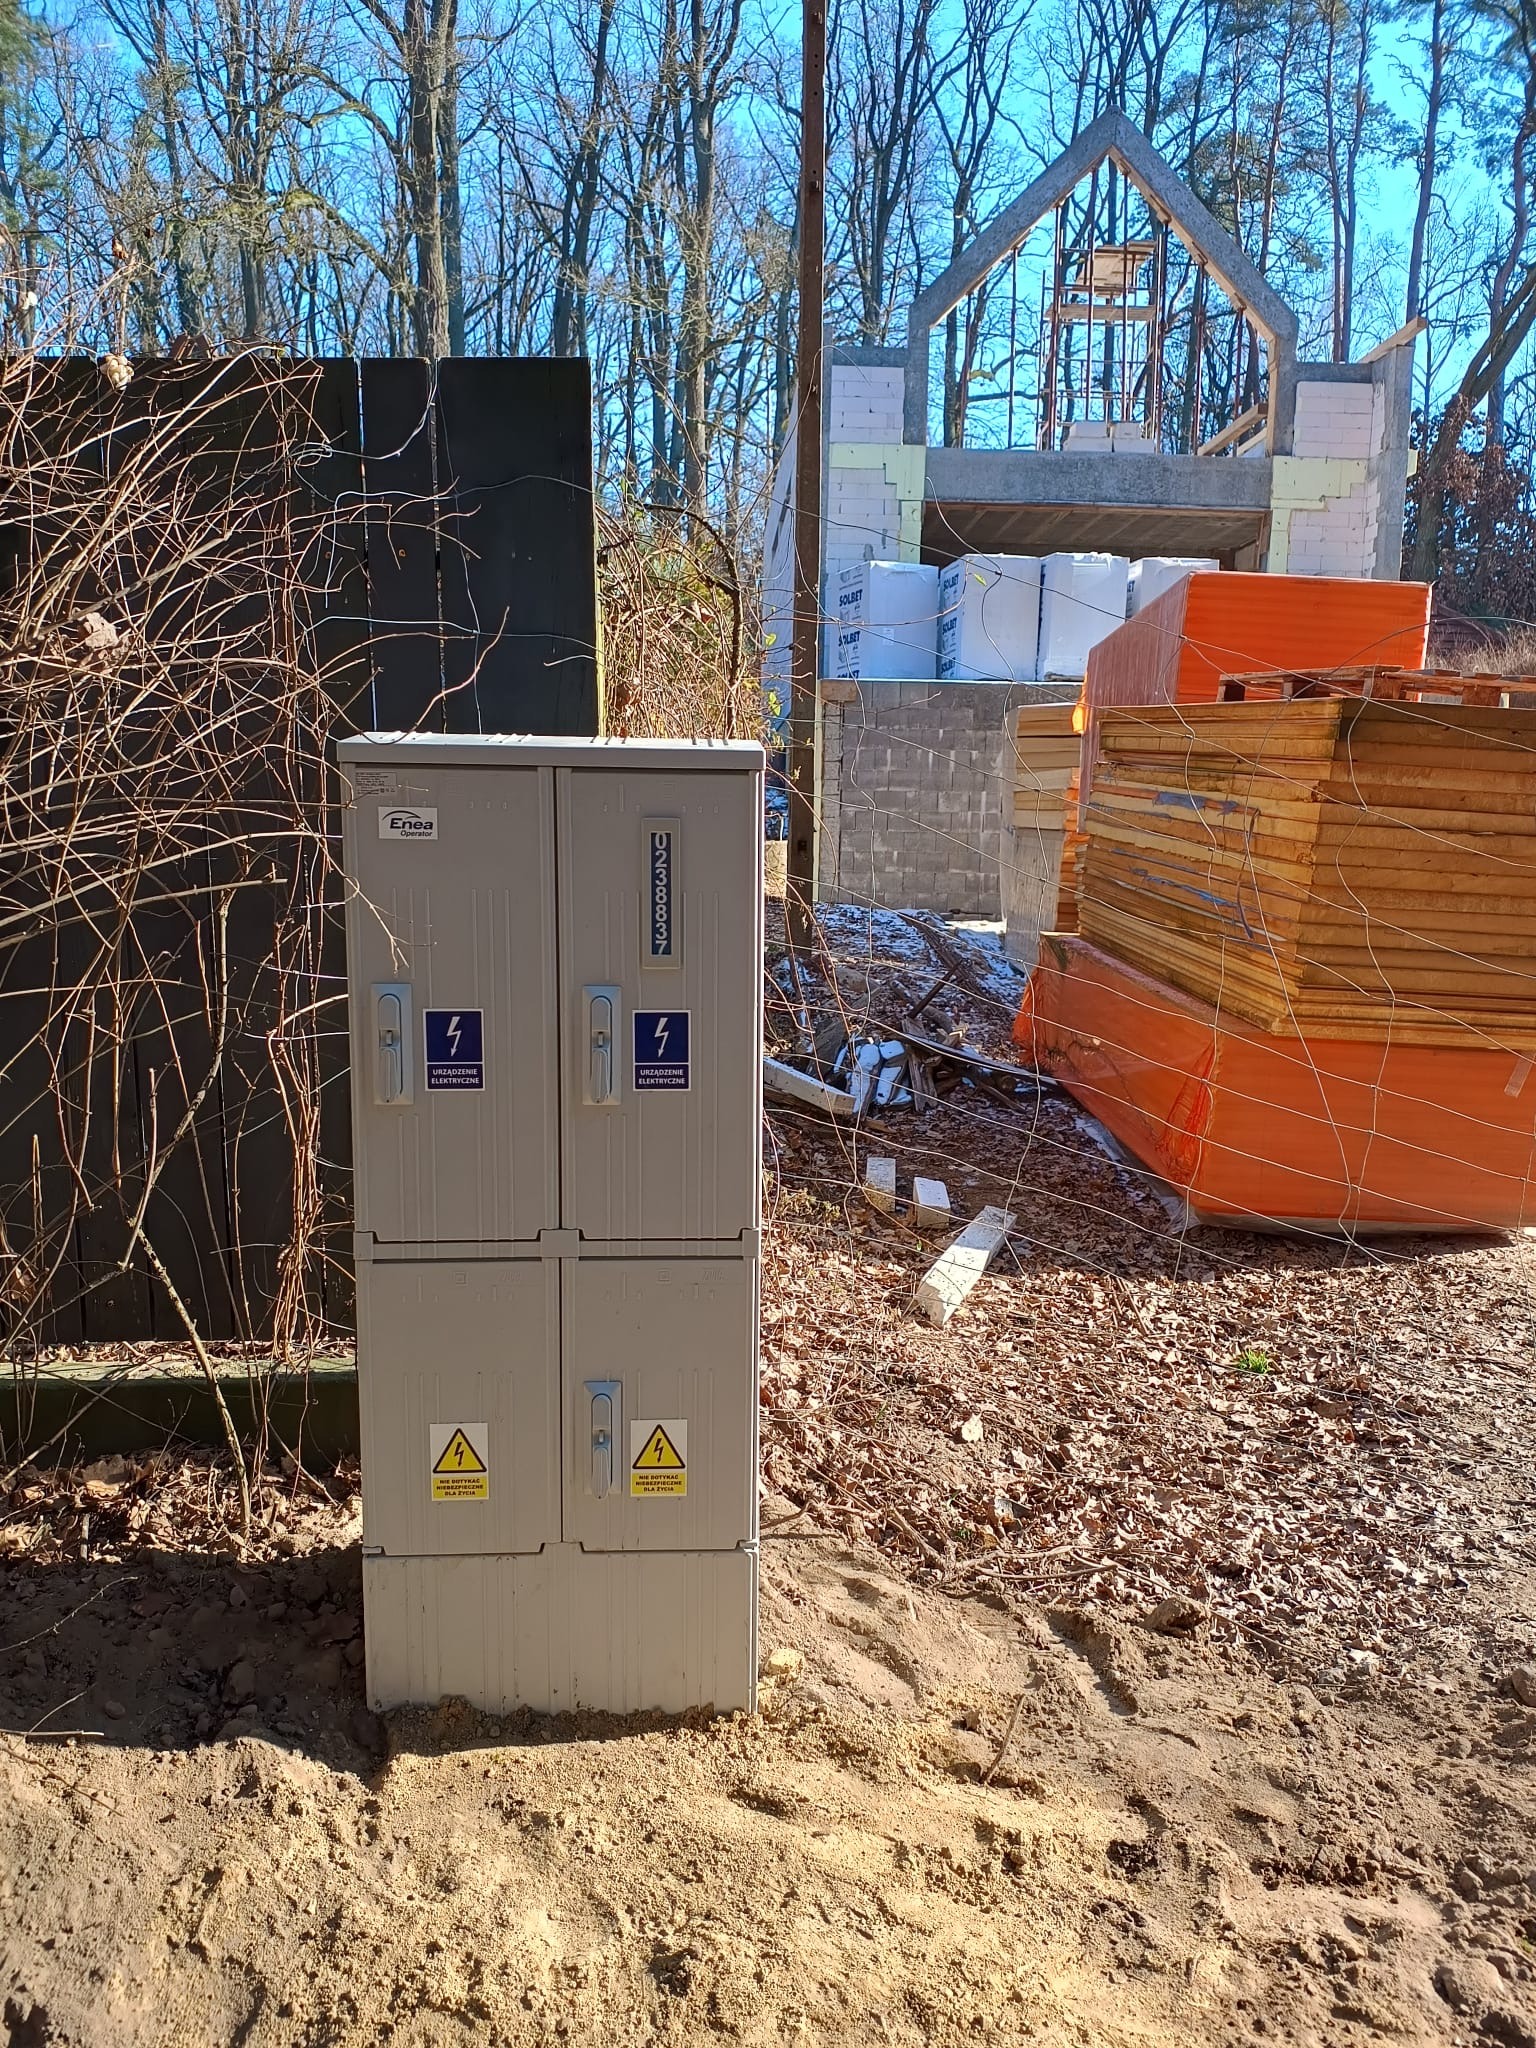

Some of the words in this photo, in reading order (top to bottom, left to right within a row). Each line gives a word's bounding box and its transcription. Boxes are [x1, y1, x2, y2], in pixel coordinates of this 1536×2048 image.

[943, 574, 959, 591] SOLBET
[839, 589, 863, 607] SOLBET
[942, 617, 957, 634] SOLBET
[838, 631, 861, 647] SOLBET
[390, 818, 434, 830] Enea
[655, 833, 668, 955] 0238837
[432, 1069, 478, 1077] URZĄDZENIE
[640, 1069, 684, 1077] URZĄDZENIE
